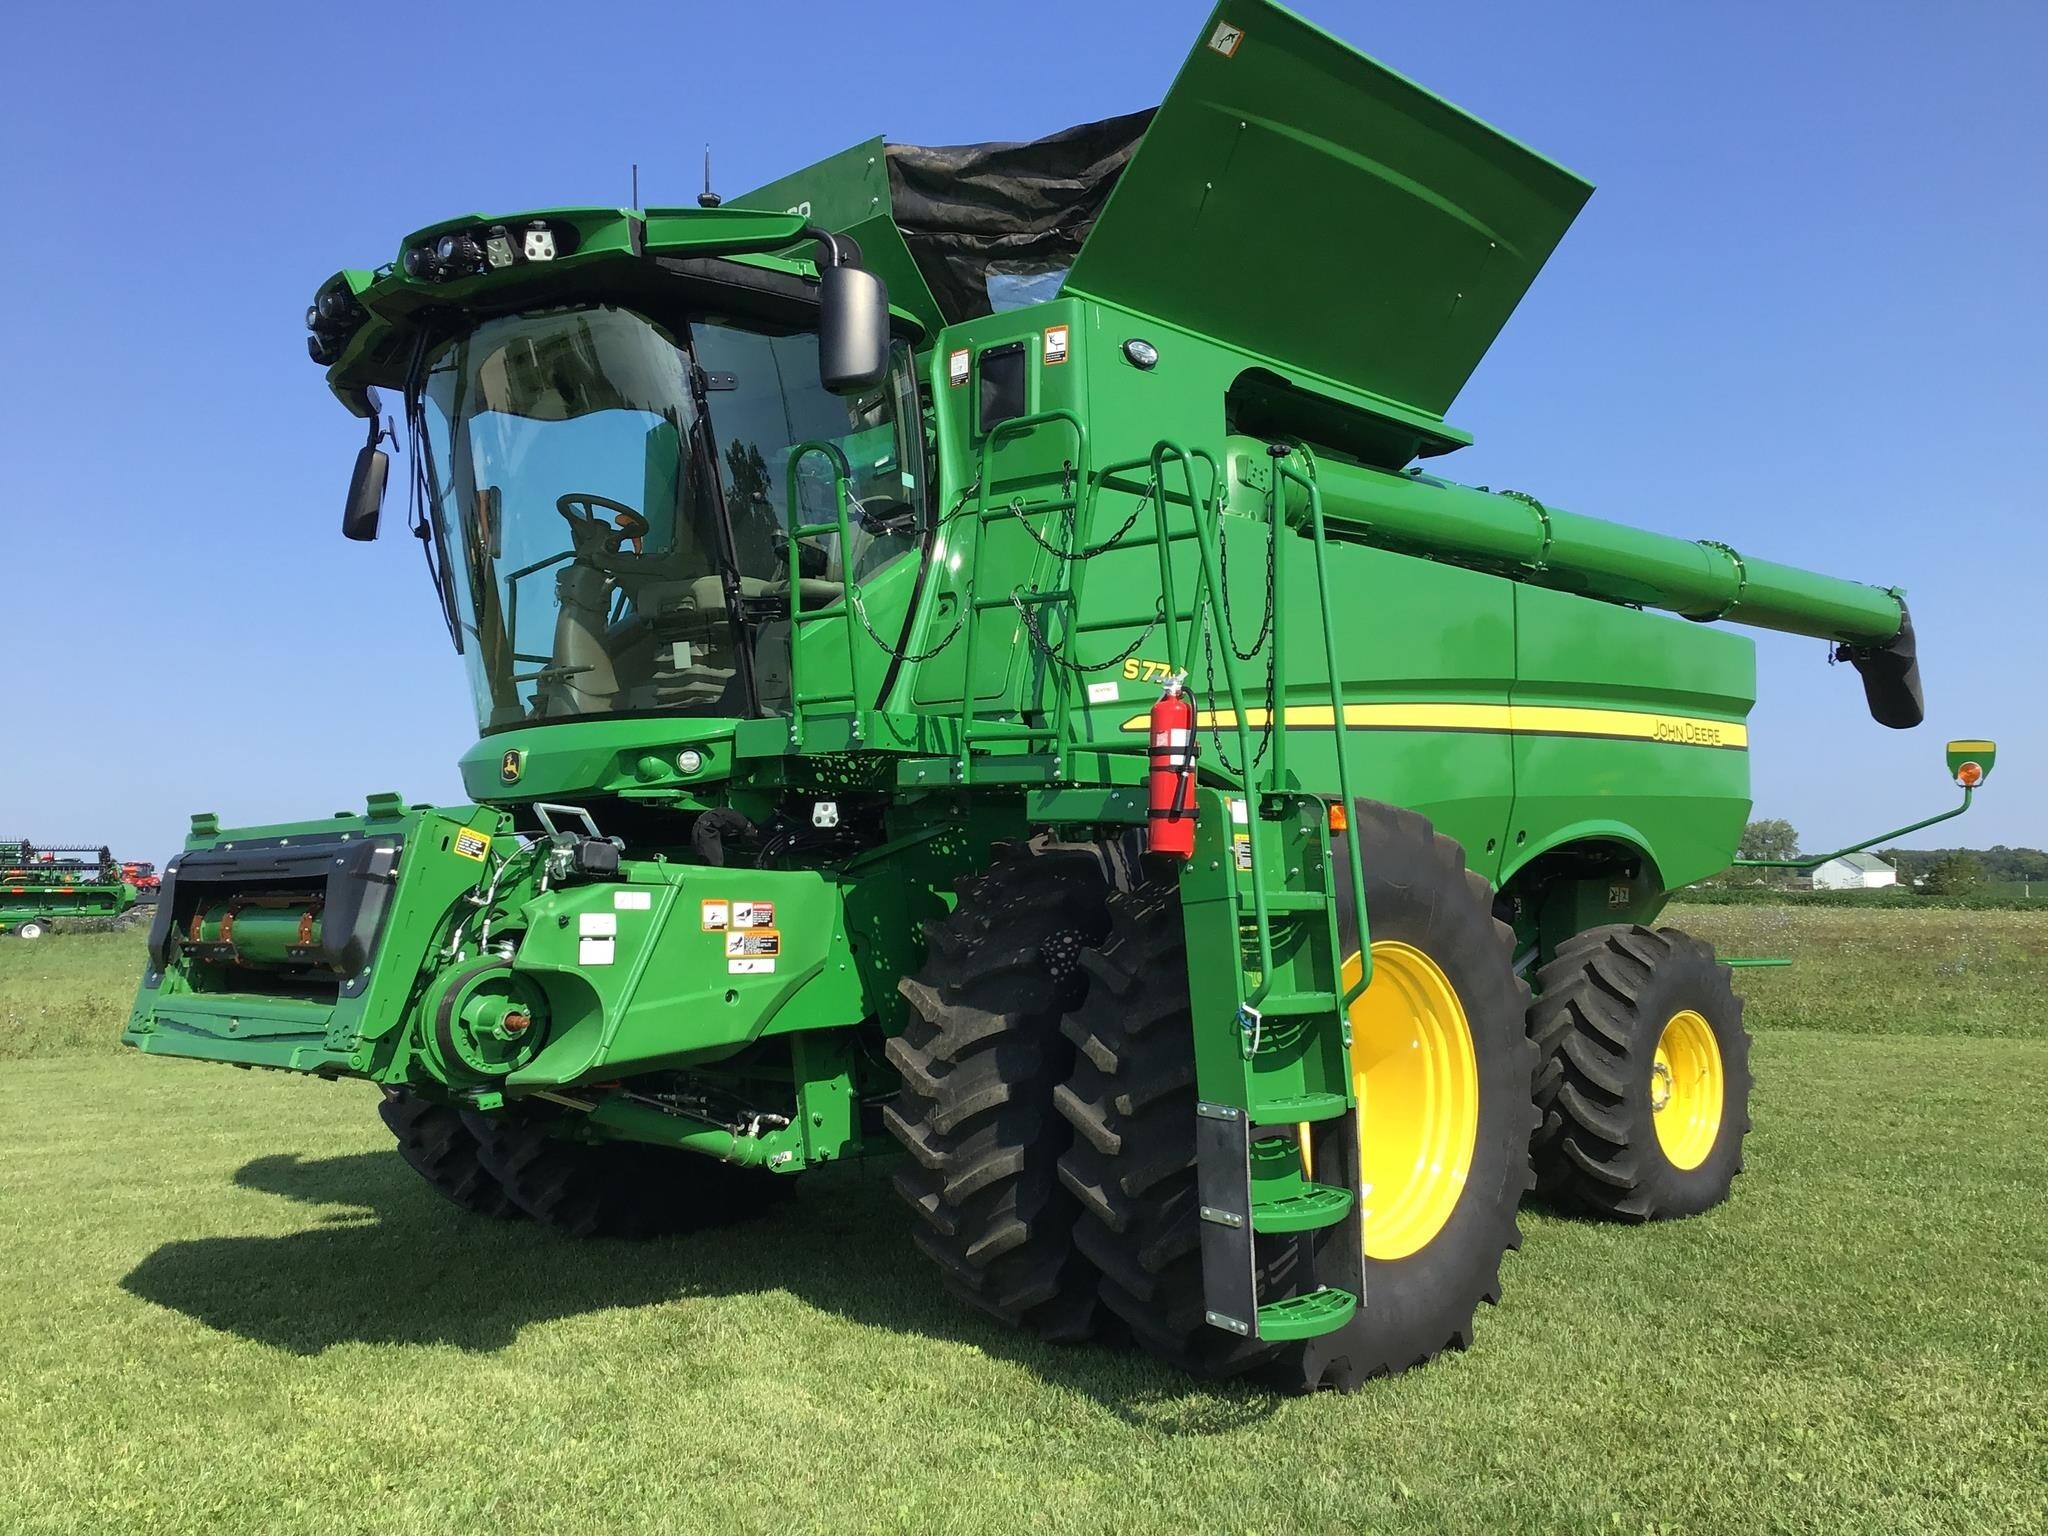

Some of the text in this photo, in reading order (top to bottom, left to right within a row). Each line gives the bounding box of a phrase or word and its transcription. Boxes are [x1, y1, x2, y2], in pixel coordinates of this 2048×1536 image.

[1123, 657, 1186, 684] S77
[1653, 719, 1721, 743] JOHN DEERE
